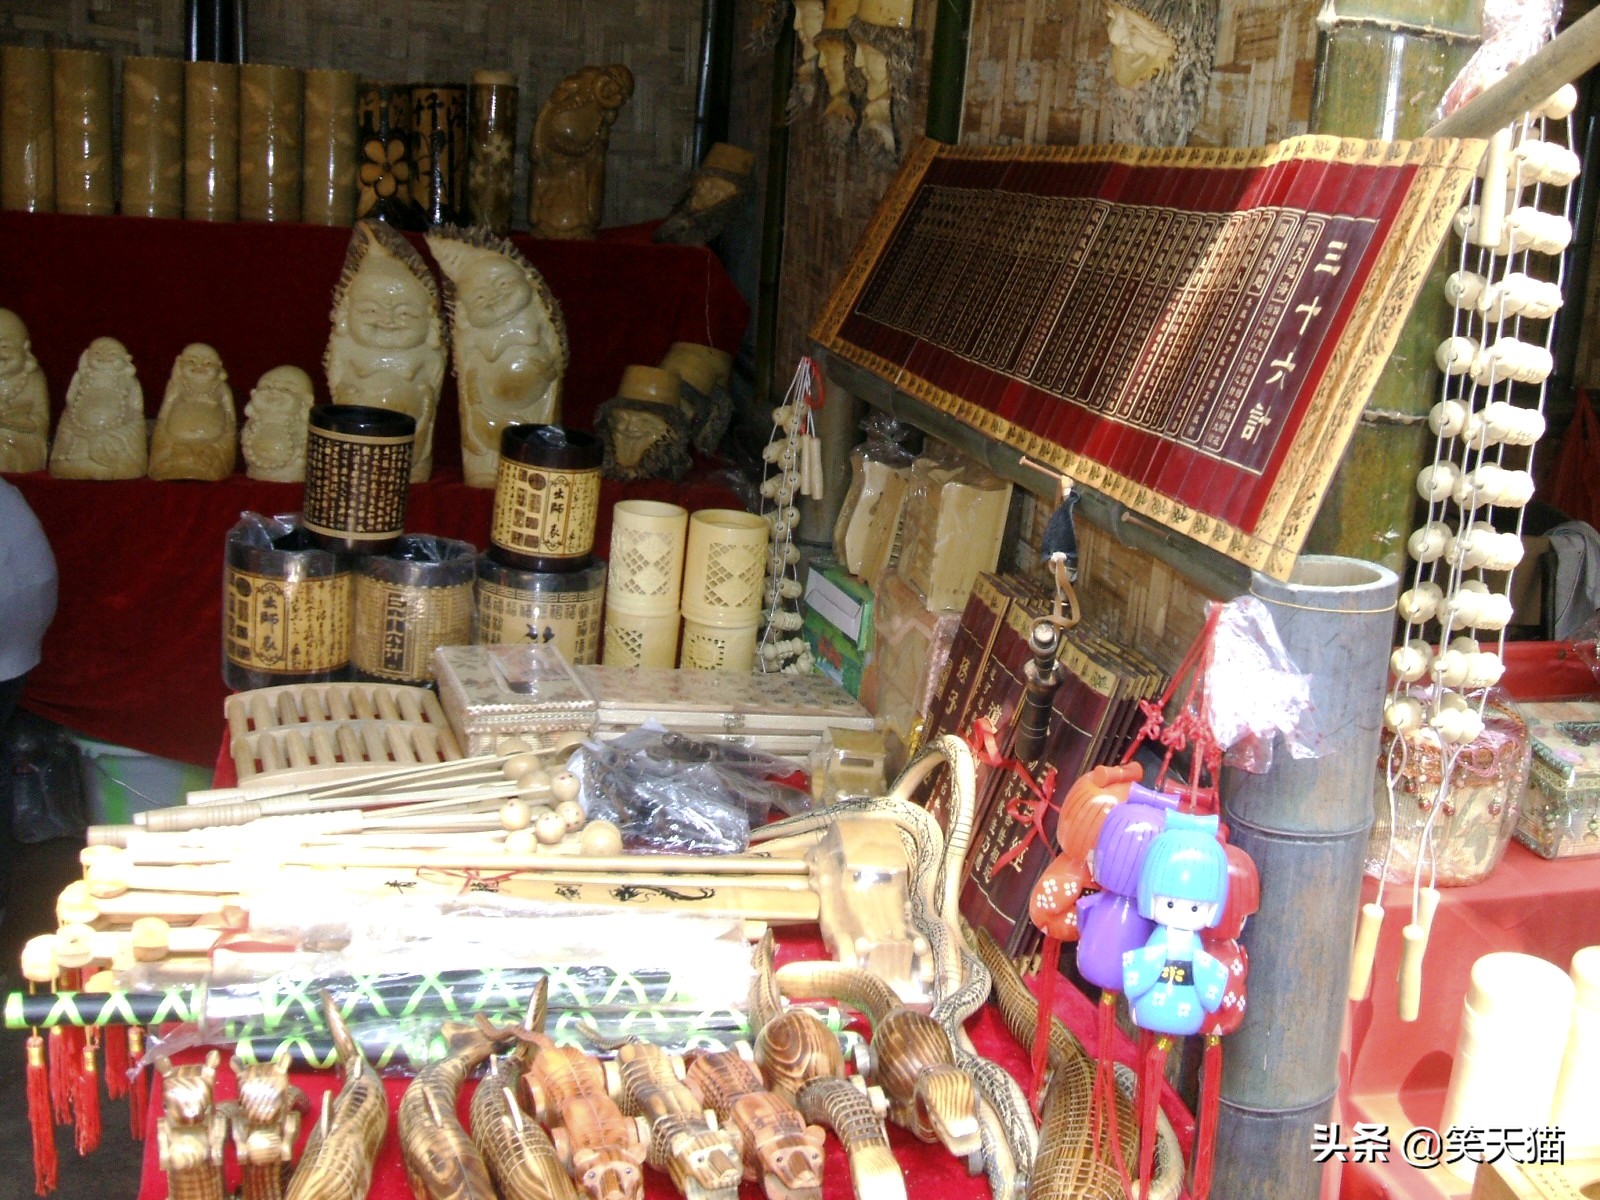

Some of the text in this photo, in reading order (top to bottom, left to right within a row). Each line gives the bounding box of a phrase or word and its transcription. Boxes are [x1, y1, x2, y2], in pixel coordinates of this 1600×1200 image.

[1241, 240, 1348, 445] 三十六計
[548, 488, 565, 540] 出師表
[260, 596, 280, 652] 出師表
